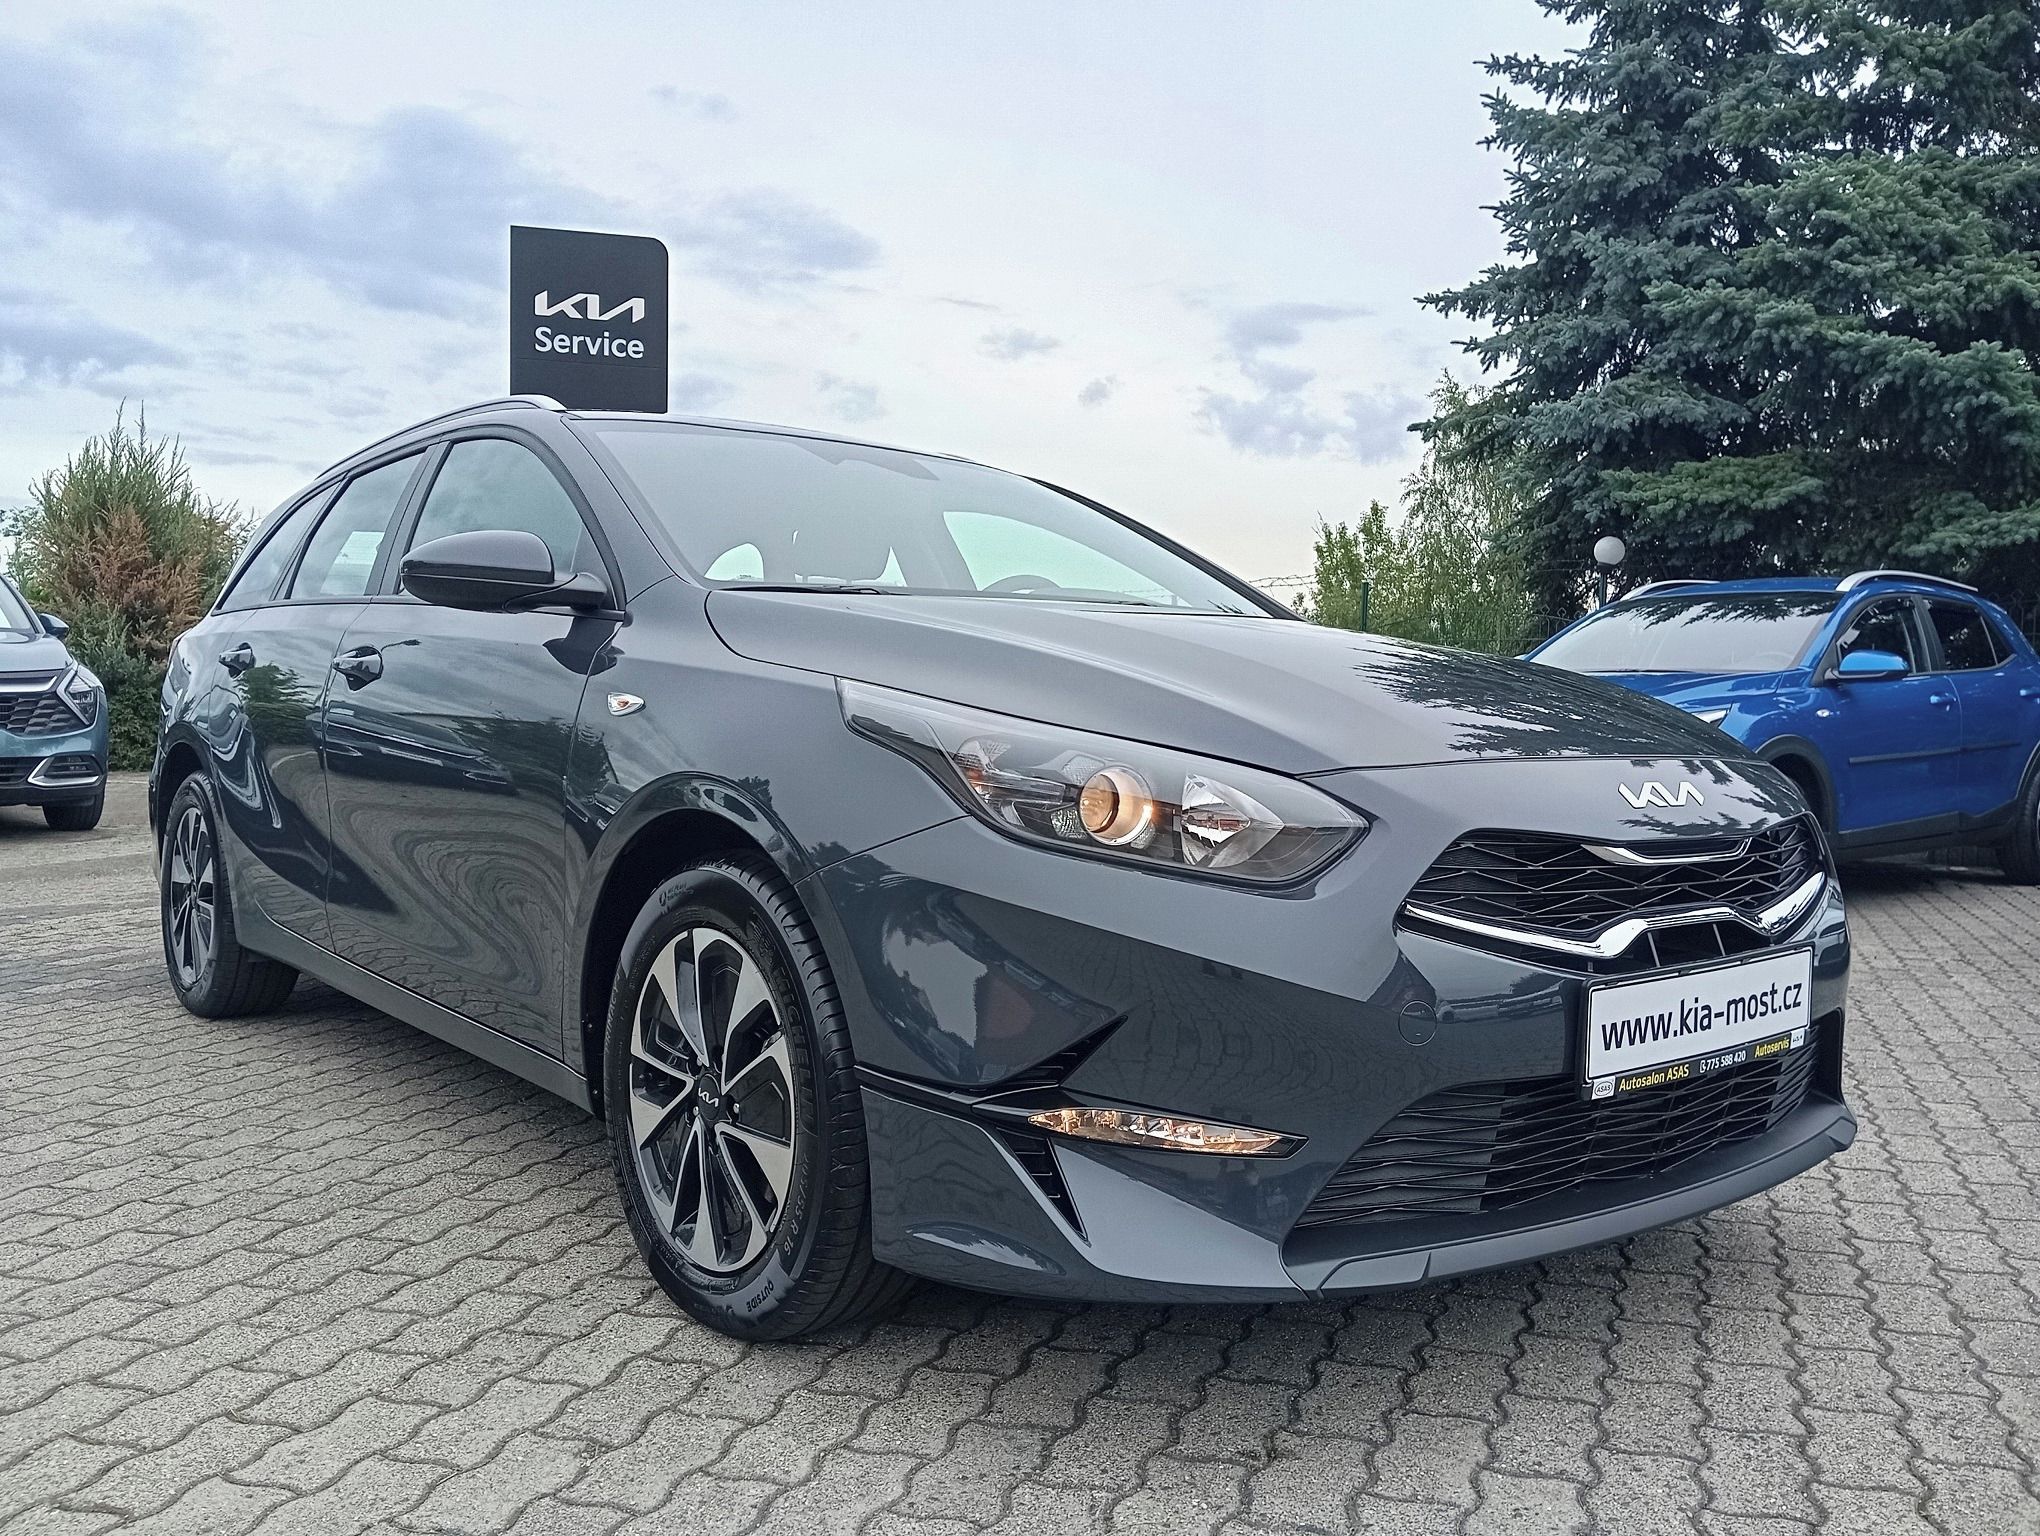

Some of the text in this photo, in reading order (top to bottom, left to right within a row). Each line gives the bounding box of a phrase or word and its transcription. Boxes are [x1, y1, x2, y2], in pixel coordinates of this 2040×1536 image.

[534, 290, 645, 324] KIA
[534, 326, 645, 359] Service
[1618, 781, 1705, 809] KIA
[1601, 982, 1803, 1051] www.kia-most.cz
[1618, 1037, 1790, 1092] Autosalon ASAS 775 588 420 Autoservis
[698, 1087, 719, 1107] KIA
[790, 1219, 799, 1235] R
[783, 1235, 794, 1256] 16
[746, 1281, 775, 1312] OUTSIDE
